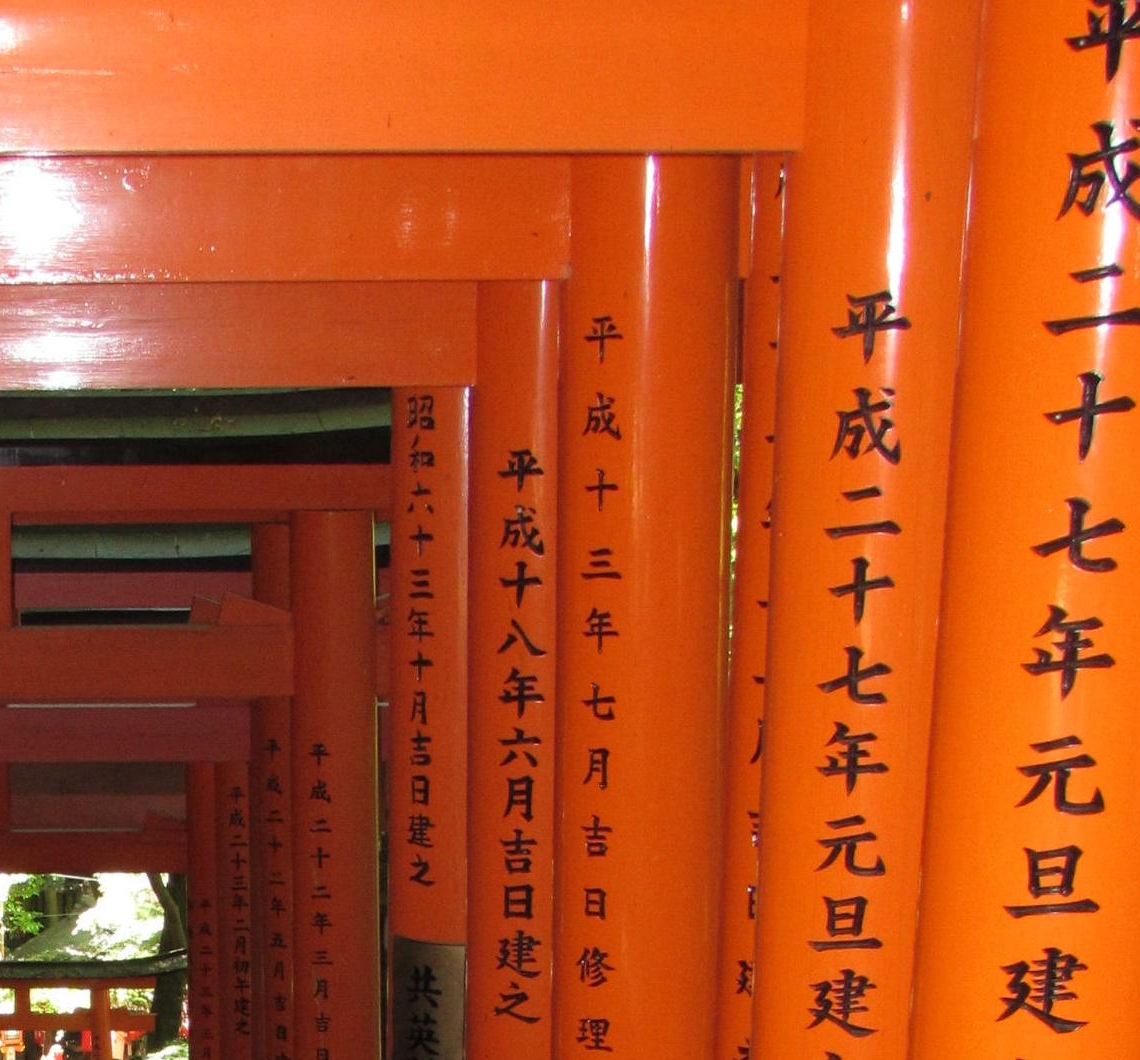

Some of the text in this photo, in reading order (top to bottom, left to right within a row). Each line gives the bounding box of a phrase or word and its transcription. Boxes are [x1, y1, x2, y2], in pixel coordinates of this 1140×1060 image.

[407, 395, 436, 887] 昭和六十三年十月吉日建之
[493, 449, 547, 1025] 平成十八年六月吉日建之
[577, 315, 624, 1052] 平成十三年七月吉日修理
